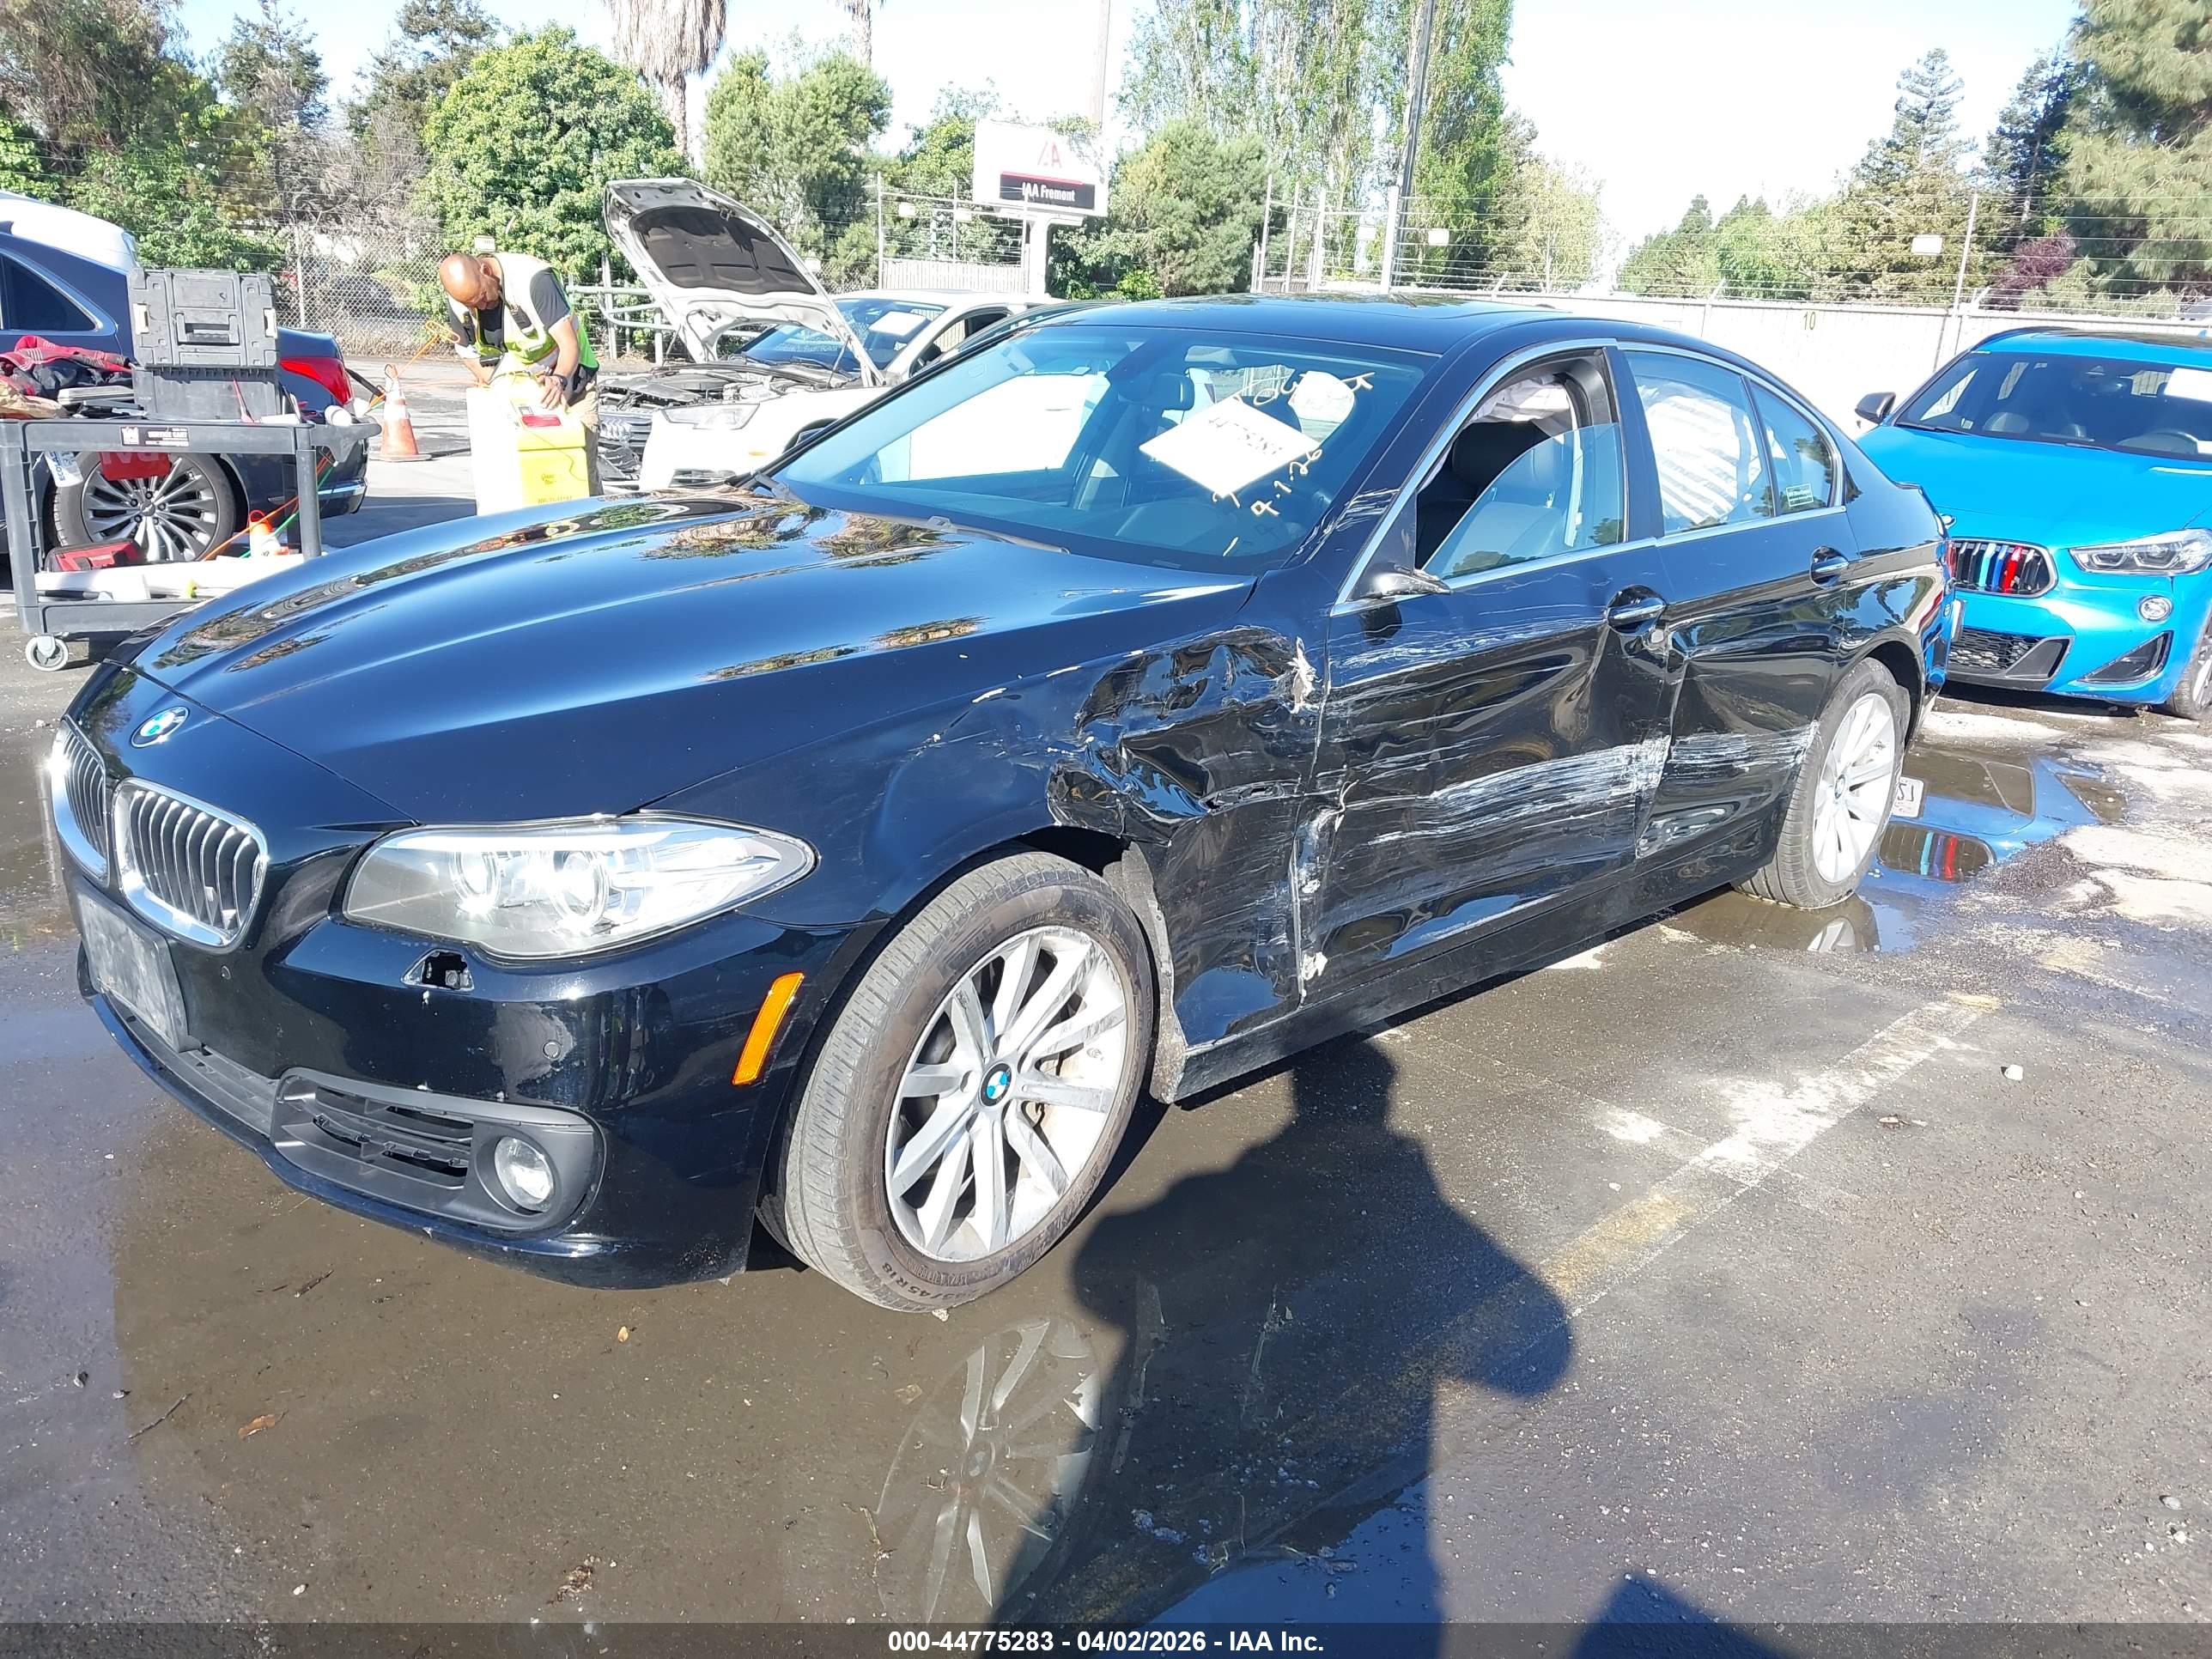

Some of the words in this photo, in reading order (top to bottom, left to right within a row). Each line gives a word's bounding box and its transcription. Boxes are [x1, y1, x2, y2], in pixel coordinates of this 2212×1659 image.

[1022, 181, 1039, 198] IAA
[1041, 184, 1076, 203] Fremont
[1803, 311, 1816, 331] 10
